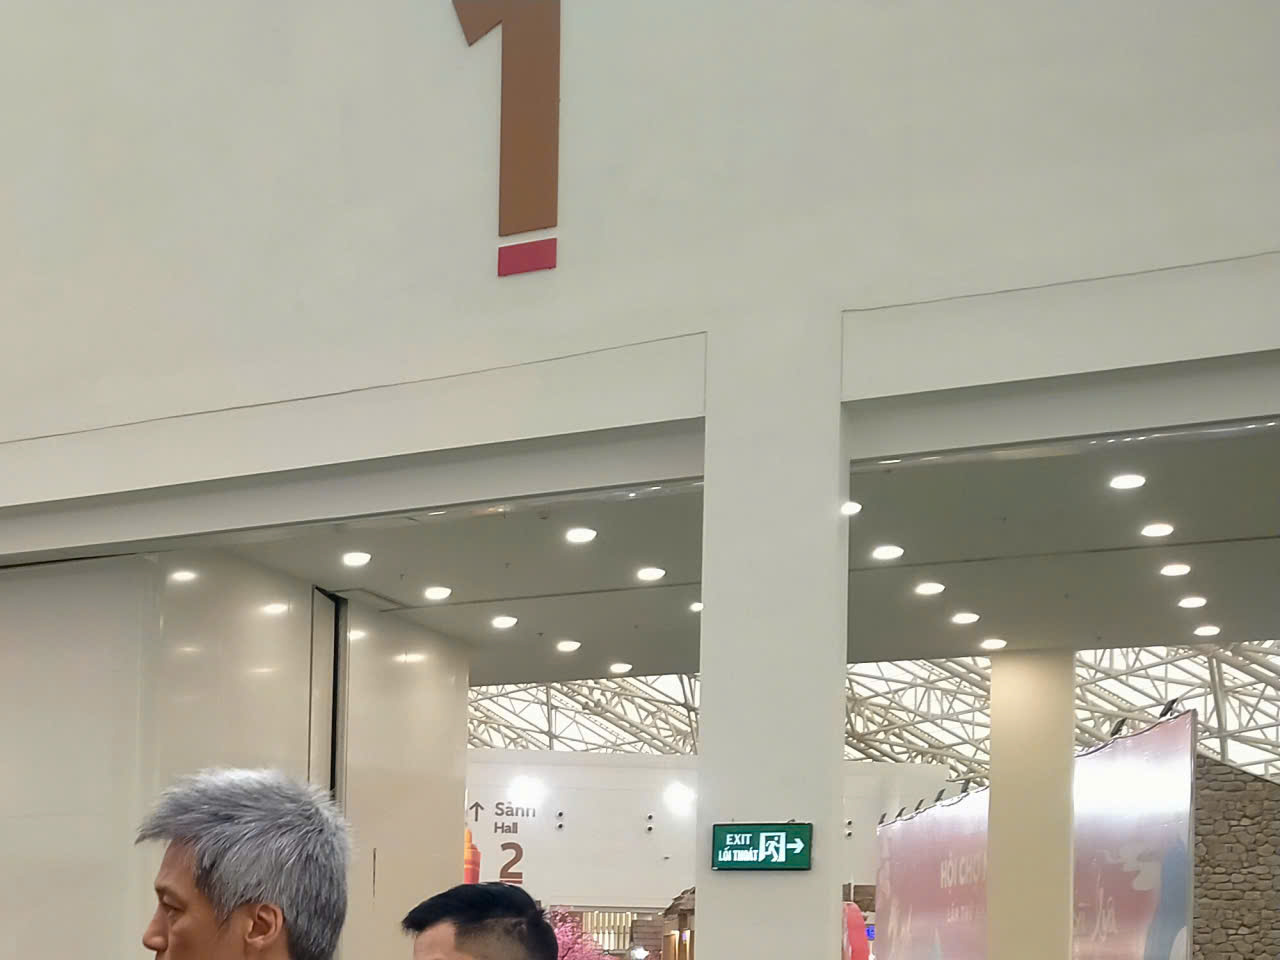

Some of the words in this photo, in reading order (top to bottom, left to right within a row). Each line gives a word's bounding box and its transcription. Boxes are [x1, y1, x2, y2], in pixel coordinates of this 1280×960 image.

[451, 0, 562, 238] 1
[494, 821, 519, 834] Hall
[725, 833, 753, 845] EXIT
[499, 841, 524, 879] 2
